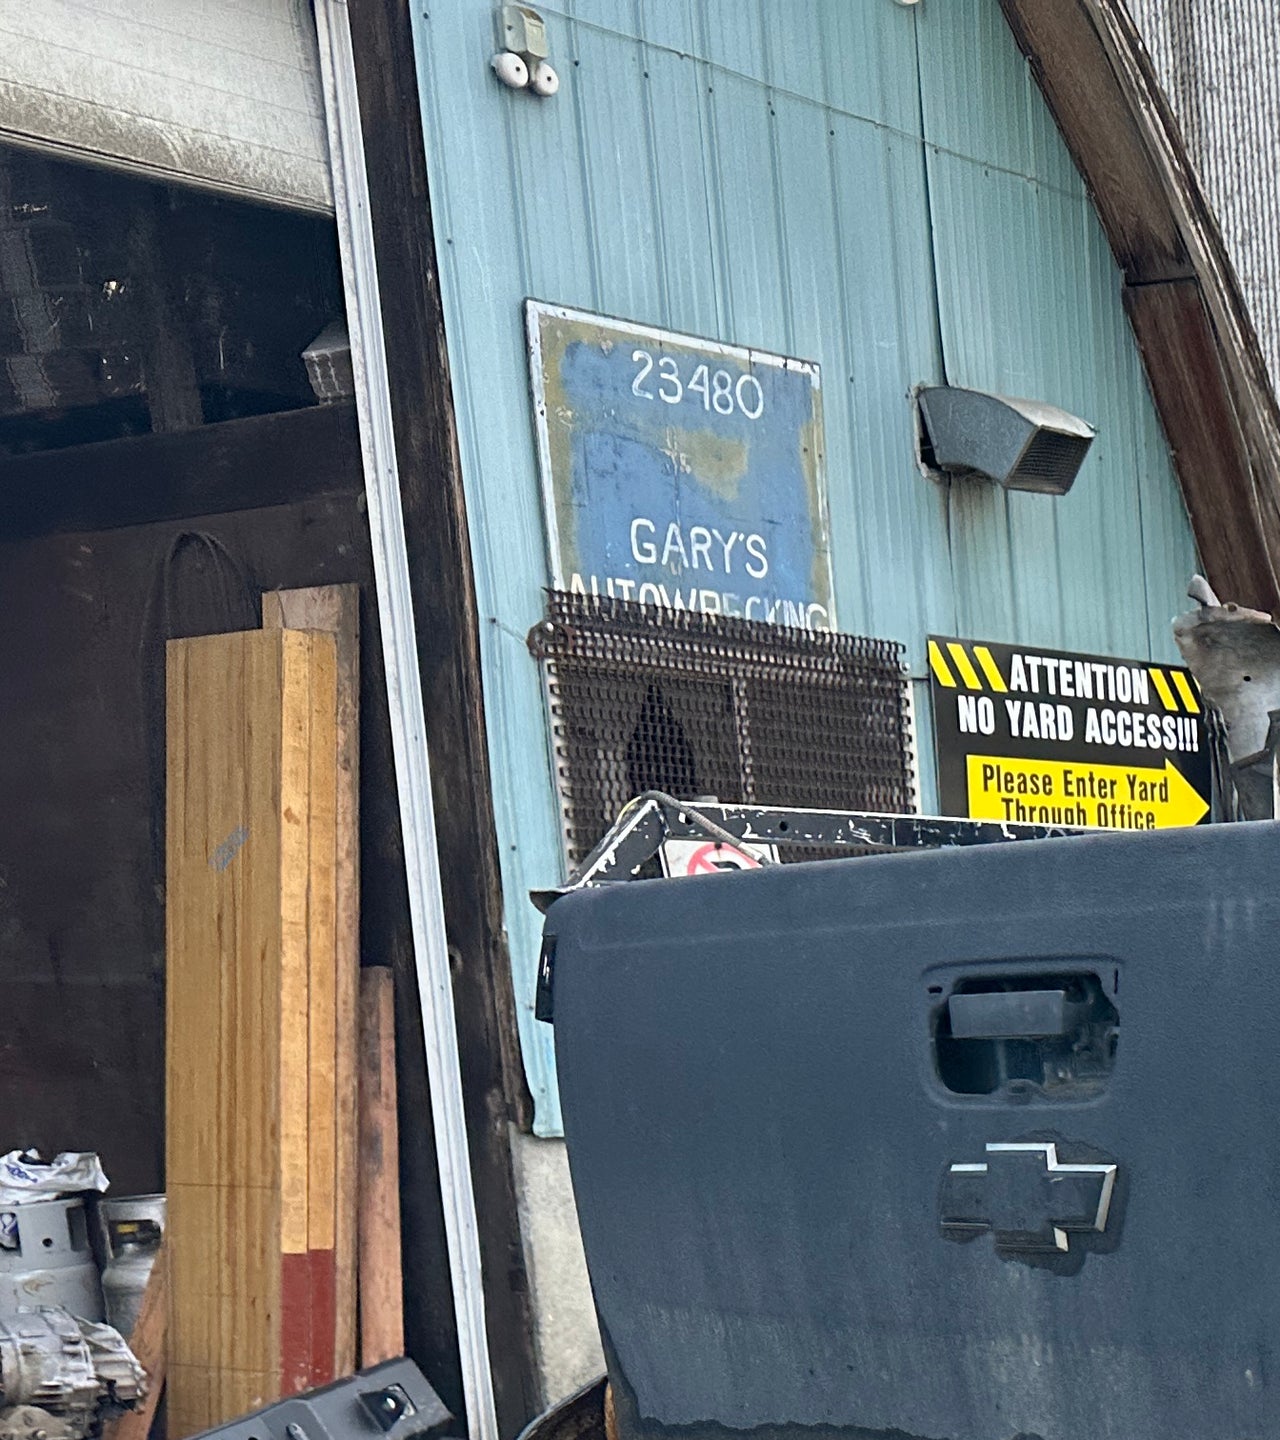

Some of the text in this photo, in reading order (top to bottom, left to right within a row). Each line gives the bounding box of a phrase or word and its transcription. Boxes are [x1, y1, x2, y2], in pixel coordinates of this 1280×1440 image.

[631, 350, 764, 420] 23480
[630, 518, 769, 579] GARY'S
[1009, 654, 1150, 705] ATTENTION
[957, 695, 1199, 753] NO YARD ACCESS!!!
[982, 764, 1168, 803] Please Enter Yard
[1001, 798, 1156, 830] Through Office
